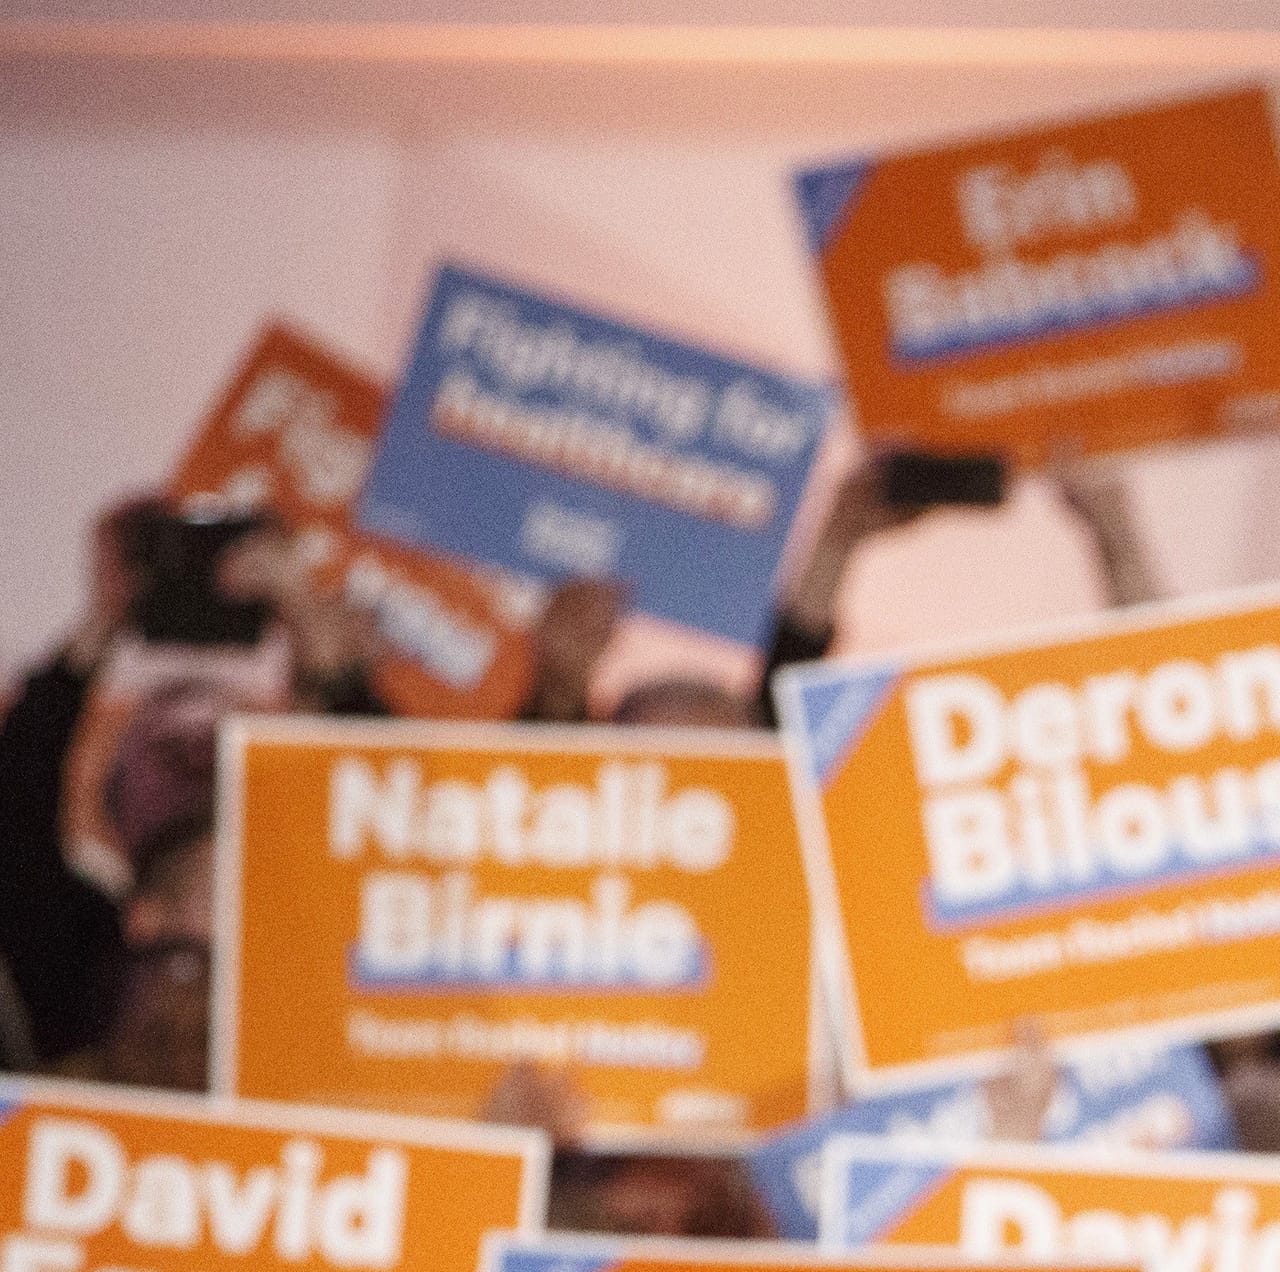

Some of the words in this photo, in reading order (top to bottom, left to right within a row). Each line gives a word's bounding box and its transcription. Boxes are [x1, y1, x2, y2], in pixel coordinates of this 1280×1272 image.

[952, 146, 1141, 252] Erin
[443, 290, 712, 443] Fighting
[709, 380, 812, 461] for
[431, 373, 783, 533] healthcare
[328, 754, 738, 874] Natalie
[356, 868, 700, 986] Birnie
[22, 1116, 409, 1271] David
